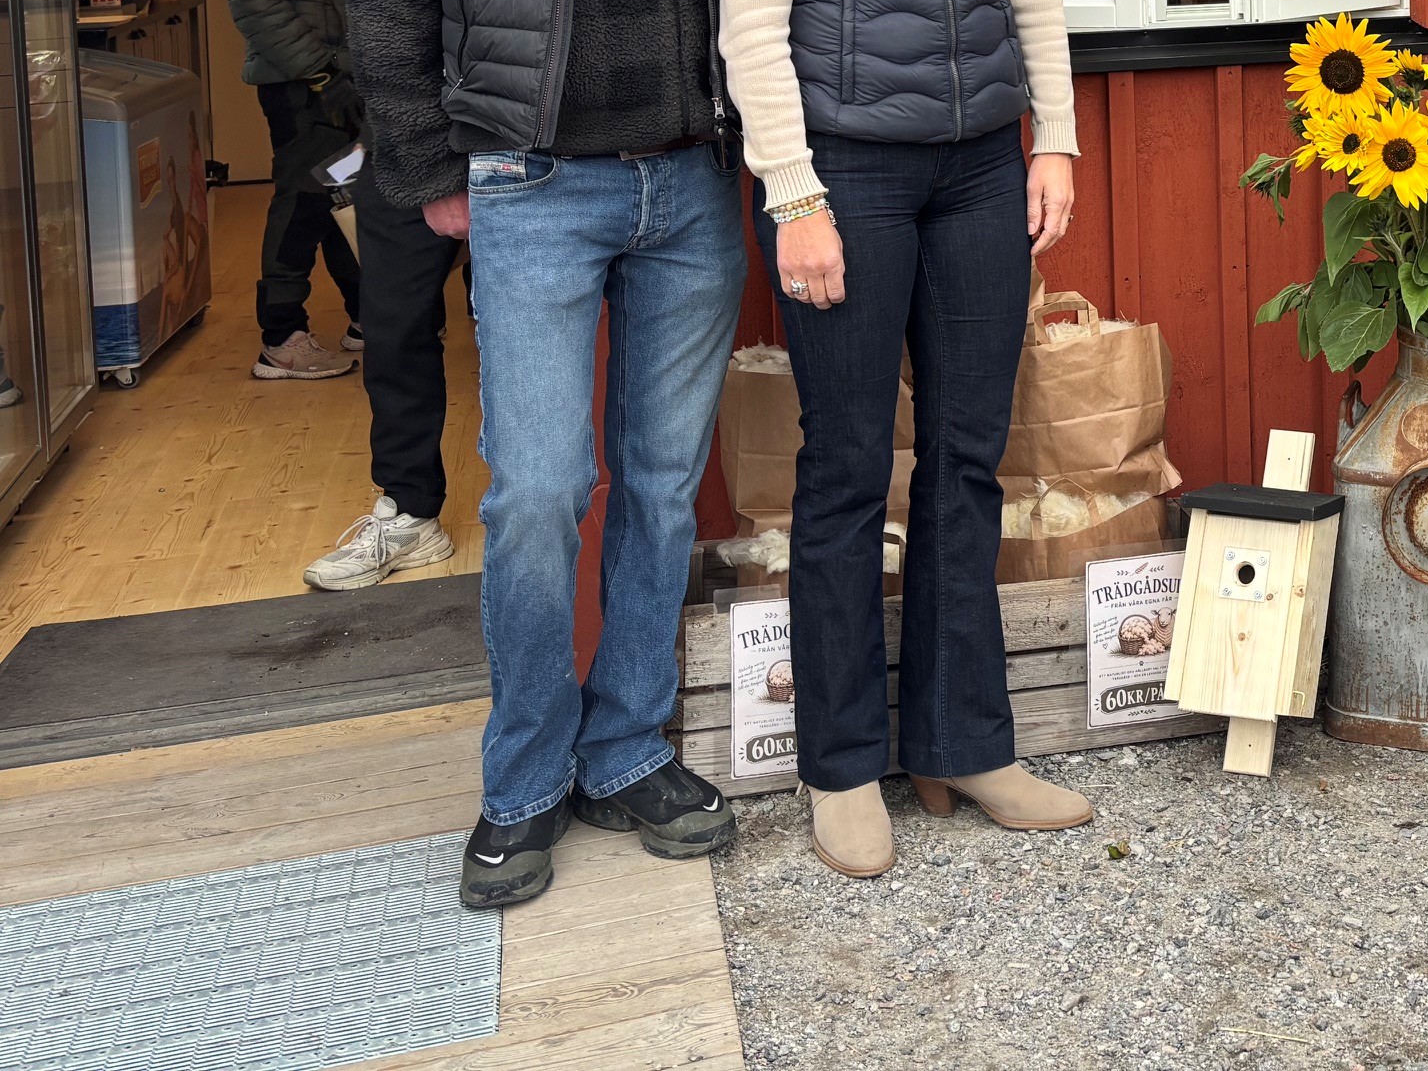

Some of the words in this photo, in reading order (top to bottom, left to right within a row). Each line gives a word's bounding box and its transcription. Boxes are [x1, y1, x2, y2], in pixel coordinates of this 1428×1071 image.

[1110, 600, 1127, 609] FRÅN
[1144, 597, 1160, 605] EGNA
[1161, 595, 1173, 603] FÅR
[757, 645, 776, 653] FRÅN
[777, 643, 790, 651] VÅR
[1105, 682, 1166, 711] 60KR/PÅ
[751, 736, 798, 760] 60KR
